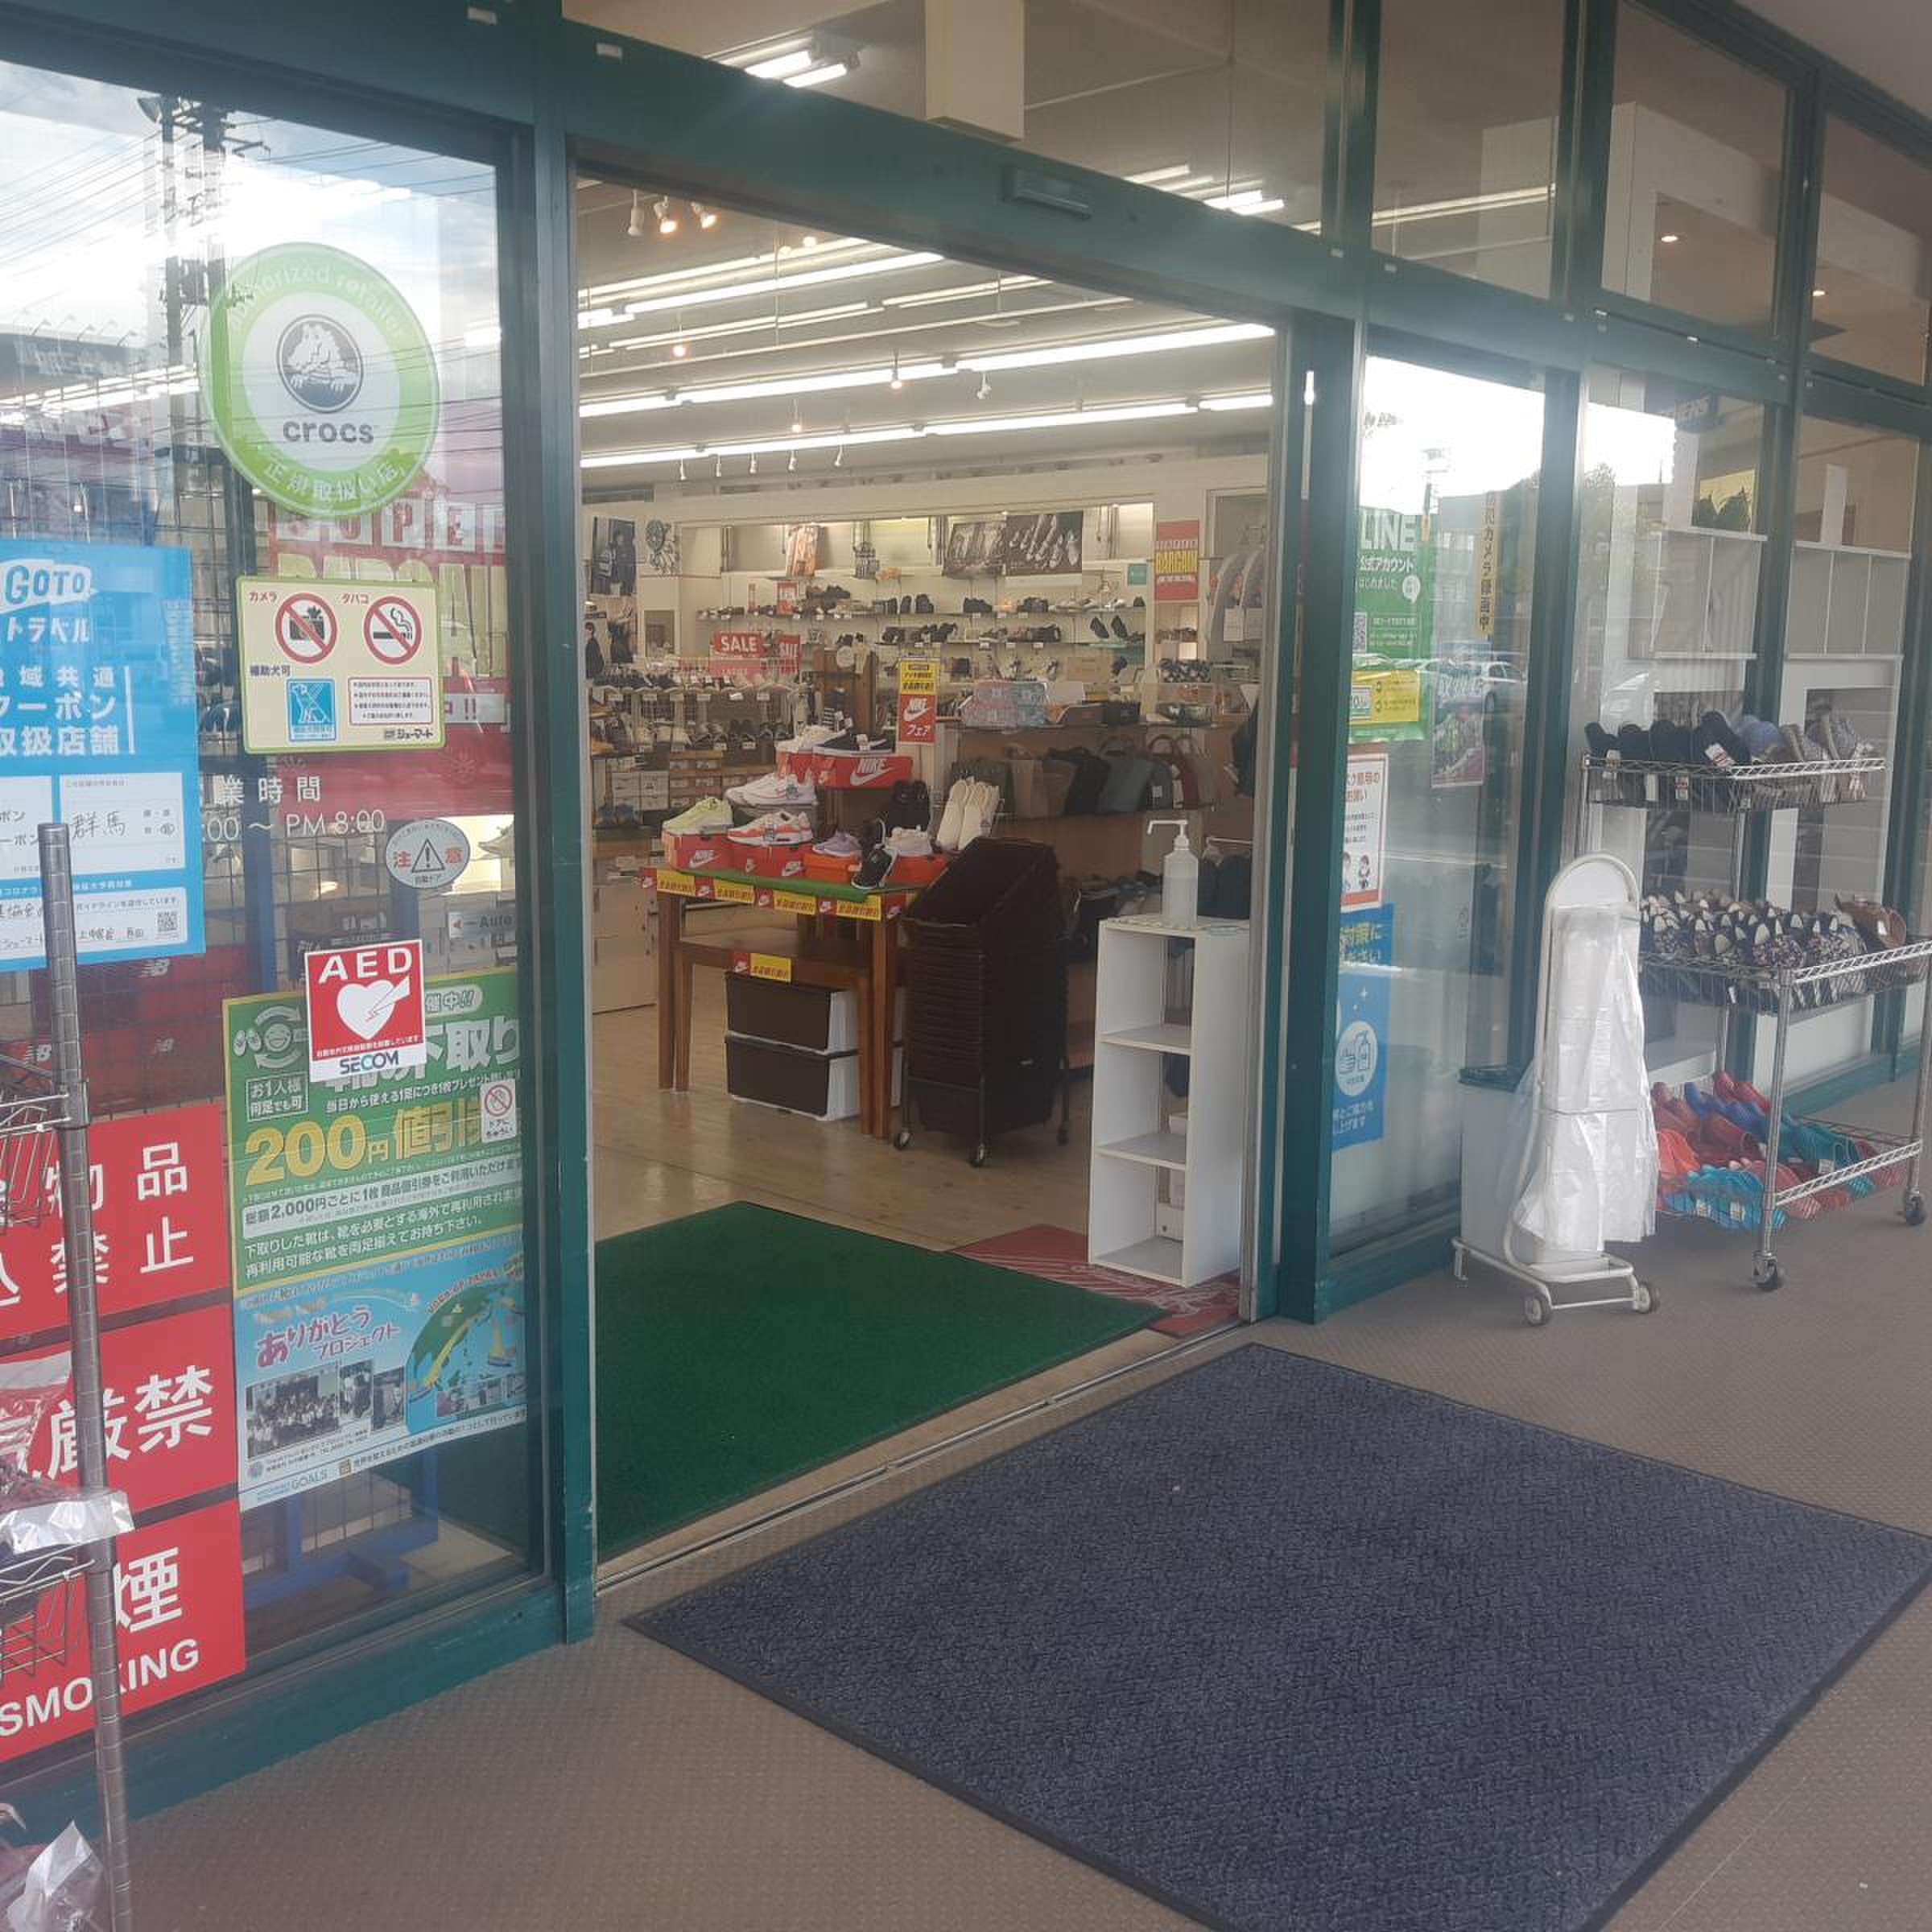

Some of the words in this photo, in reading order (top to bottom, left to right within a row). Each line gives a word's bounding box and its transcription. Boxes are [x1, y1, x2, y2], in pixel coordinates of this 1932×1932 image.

[283, 420, 374, 444] crocs
[1358, 511, 1417, 551] LINE
[5, 565, 85, 605] GOTO
[248, 591, 278, 603] カメラ
[341, 592, 369, 605] タバコ
[6, 617, 91, 643] トラベル
[720, 634, 758, 653] SALE
[0, 665, 115, 688] 域共通
[250, 664, 291, 678] 補助犬可
[857, 757, 887, 774] NIKE
[201, 775, 321, 805] 業時間
[285, 813, 328, 837] PM
[334, 810, 386, 836] 8:00
[479, 914, 514, 928] Auto
[318, 947, 413, 985] AED
[339, 1050, 400, 1075] SECOM
[258, 1303, 371, 1367] ありがとう
[317, 1323, 400, 1360] プロジェクト
[0, 1638, 200, 1737] SMOING
